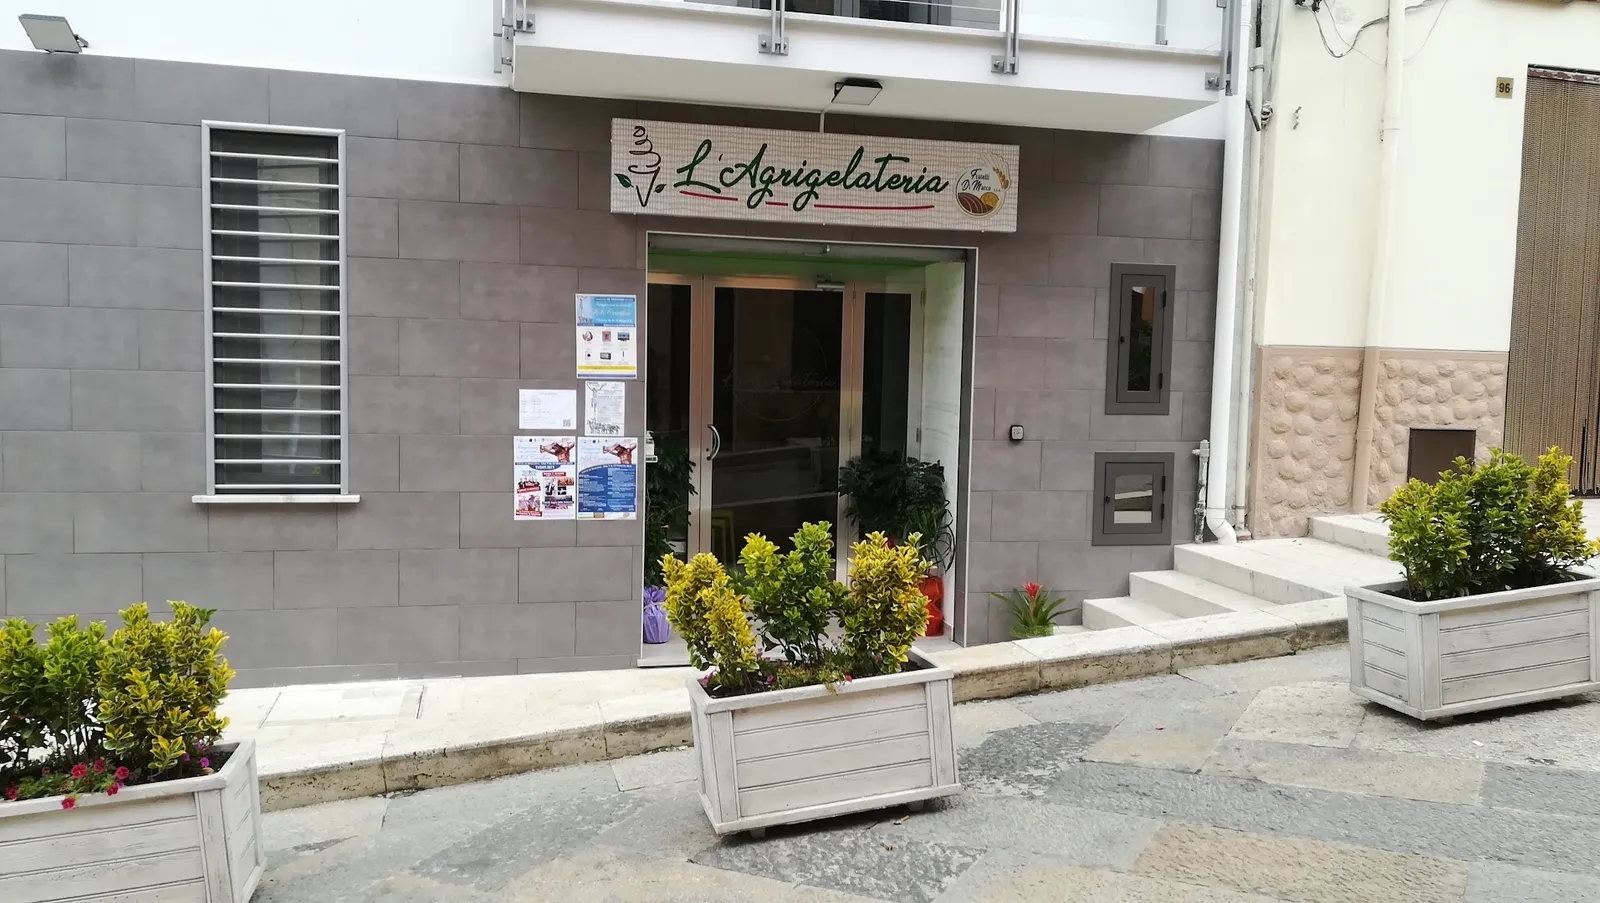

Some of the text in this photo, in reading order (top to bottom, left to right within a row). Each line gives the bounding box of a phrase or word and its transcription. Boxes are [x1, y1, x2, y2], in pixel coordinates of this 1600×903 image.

[1499, 82, 1511, 94] 96
[970, 168, 990, 180] Fratelli
[972, 179, 992, 192] Marco
